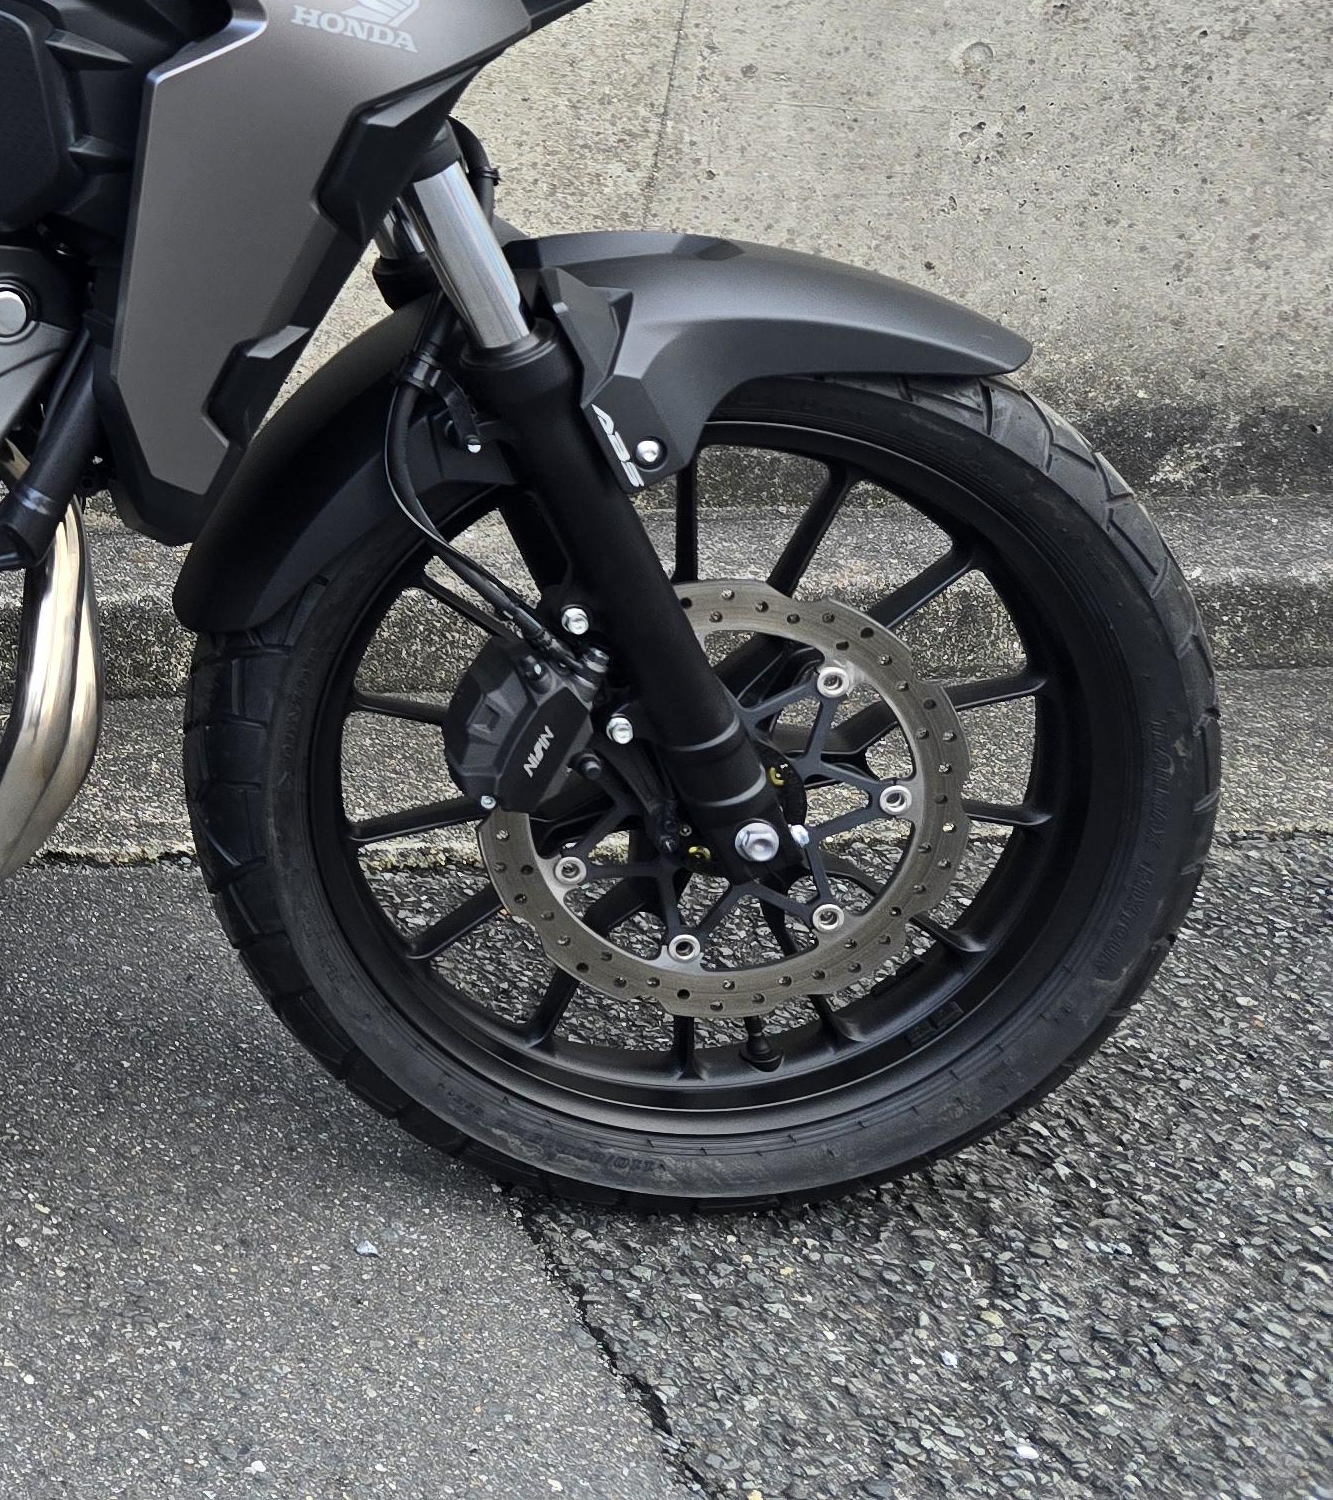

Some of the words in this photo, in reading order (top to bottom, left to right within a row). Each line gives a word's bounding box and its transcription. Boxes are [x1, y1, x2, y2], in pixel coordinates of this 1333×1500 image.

[291, 4, 418, 53] HONDA
[591, 404, 644, 487] ABS
[523, 725, 555, 778] NISSIN
